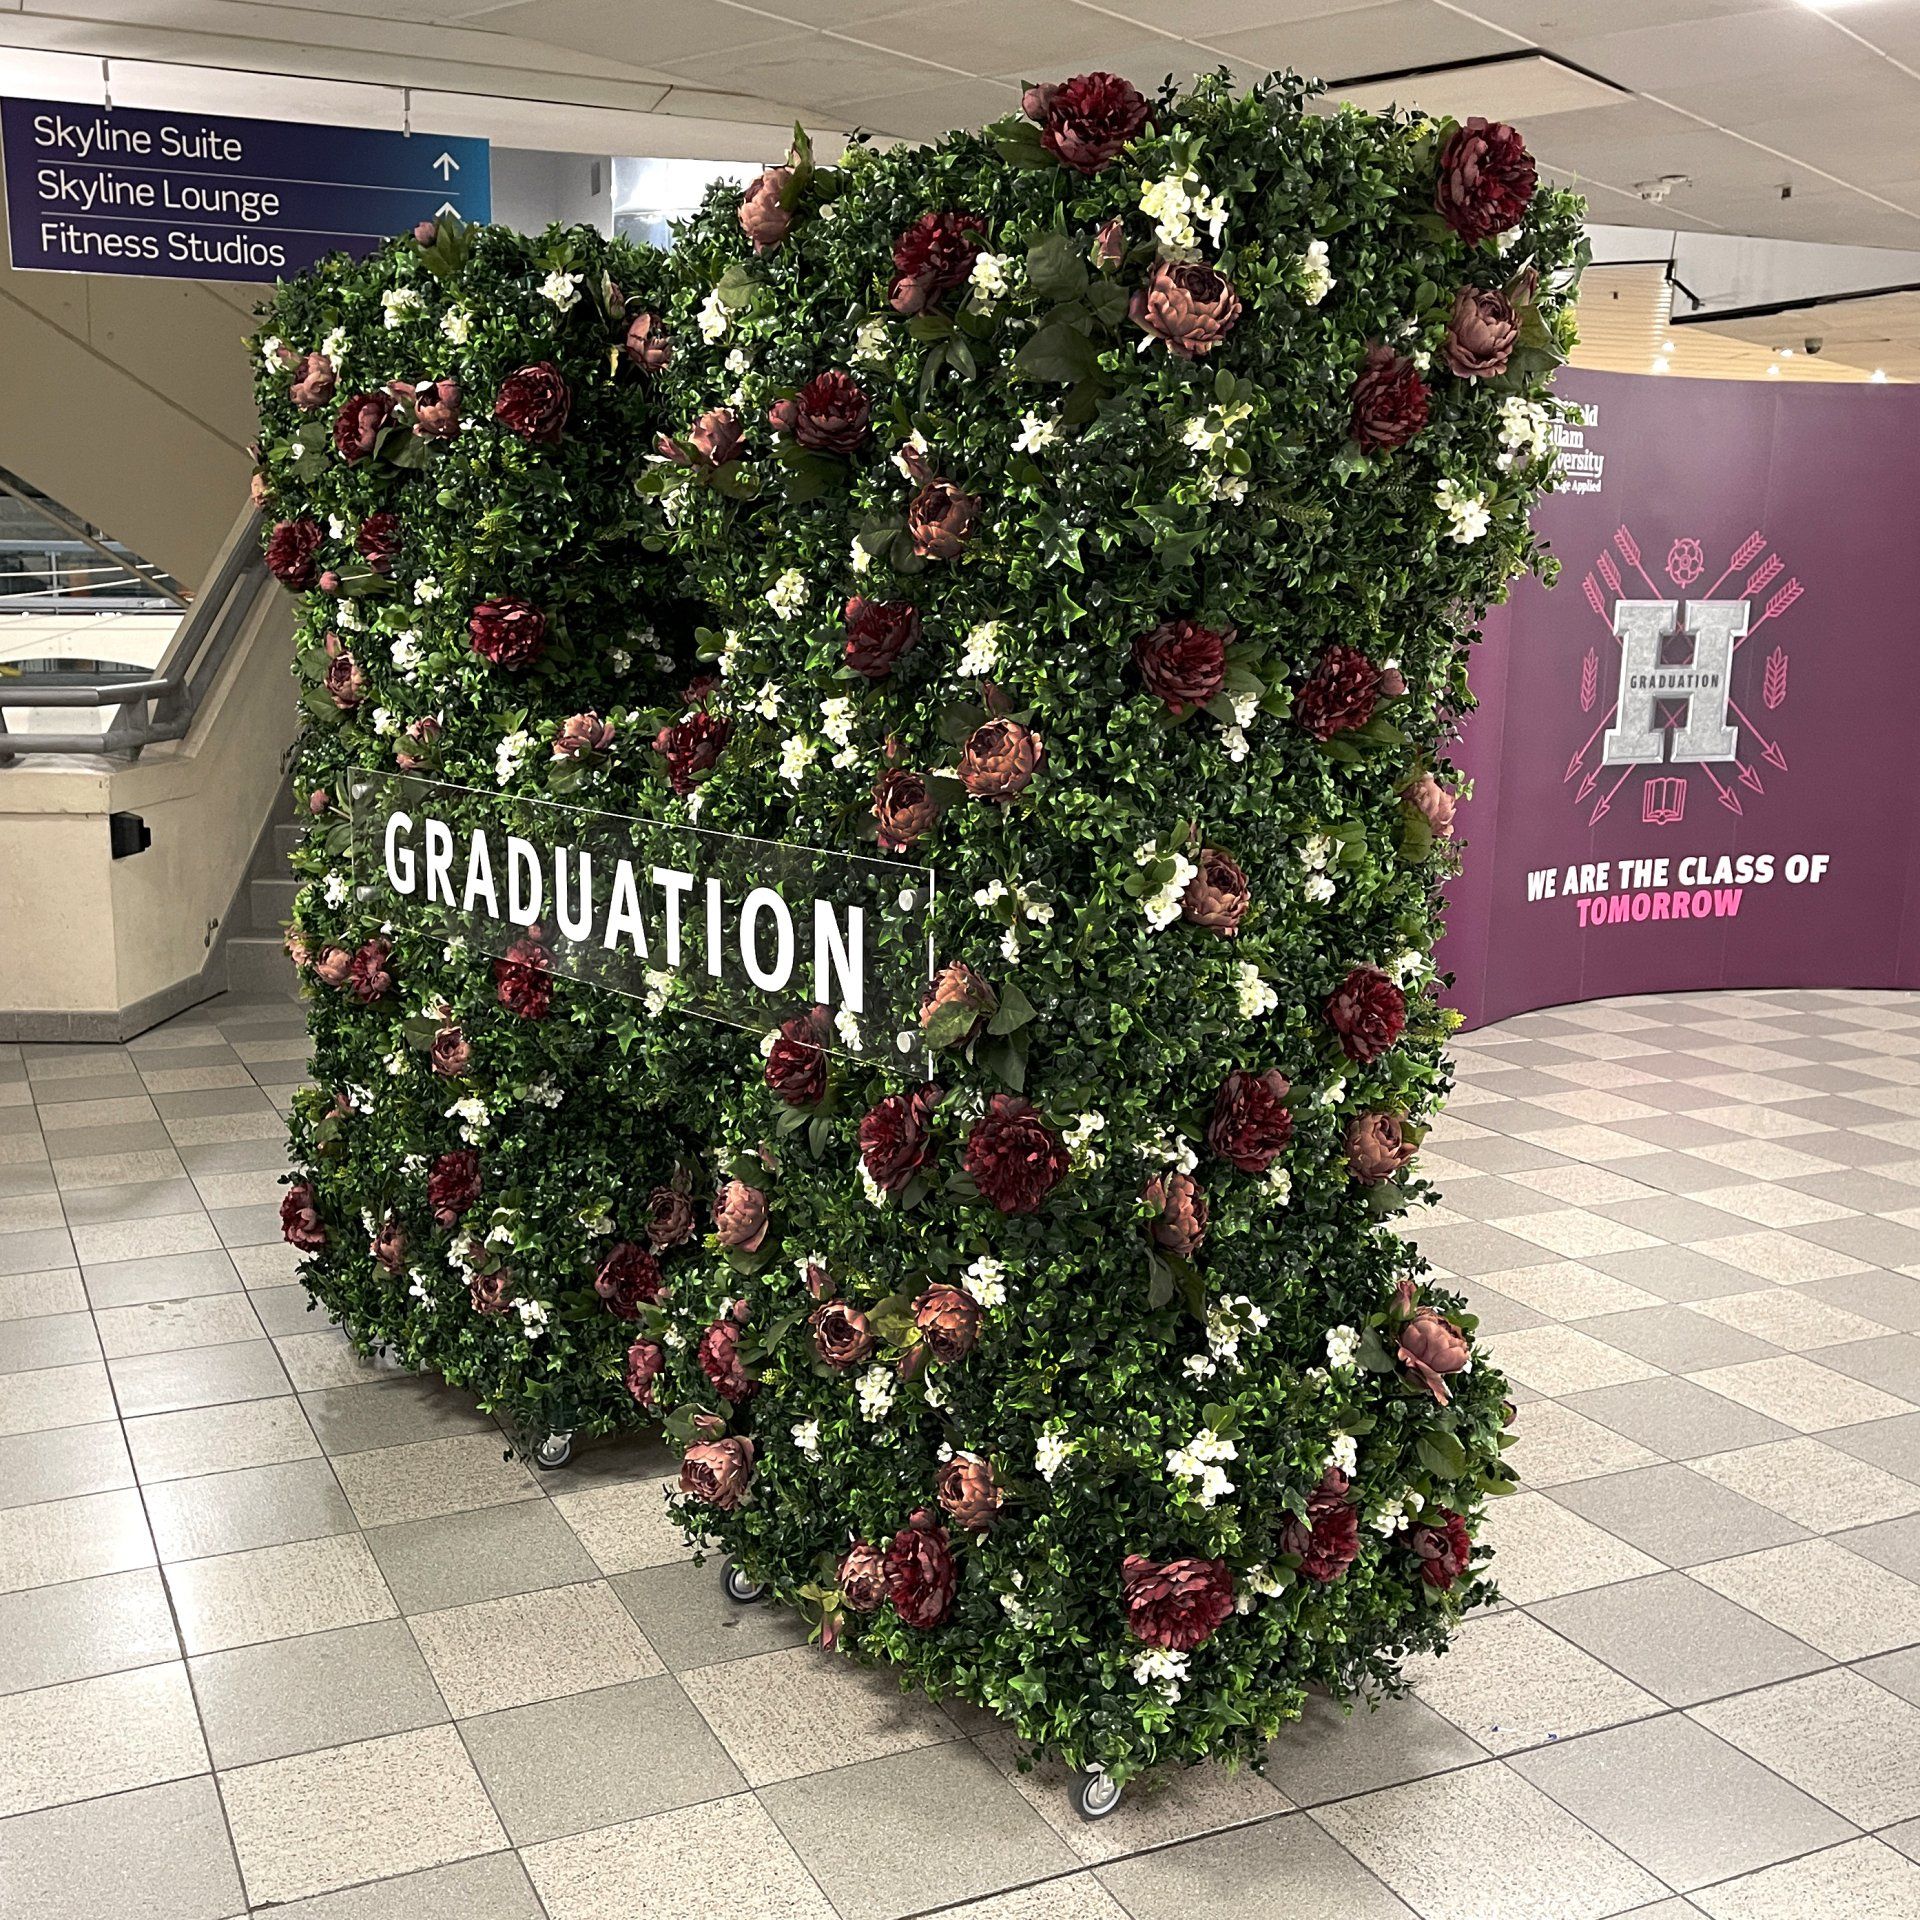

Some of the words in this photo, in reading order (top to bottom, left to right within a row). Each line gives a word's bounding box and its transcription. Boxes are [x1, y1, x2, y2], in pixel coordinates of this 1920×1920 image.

[34, 115, 152, 157] Skyline
[161, 126, 242, 161] Suite
[37, 170, 155, 212] Skyline
[164, 180, 280, 222] Lounge
[42, 222, 159, 260] Fitness
[168, 231, 285, 267] Studios
[1552, 449, 1604, 478] versity
[1571, 479, 1601, 495] Applied
[1630, 674, 1719, 690] GRADUATION
[1527, 868, 1557, 901] WE
[1562, 862, 1610, 895] ARE
[1618, 858, 1669, 889] THE
[1678, 855, 1775, 885] CLASS
[1784, 854, 1829, 883] OF
[384, 811, 864, 1013] GRADUATION
[1577, 889, 1743, 927] TOMORROW
